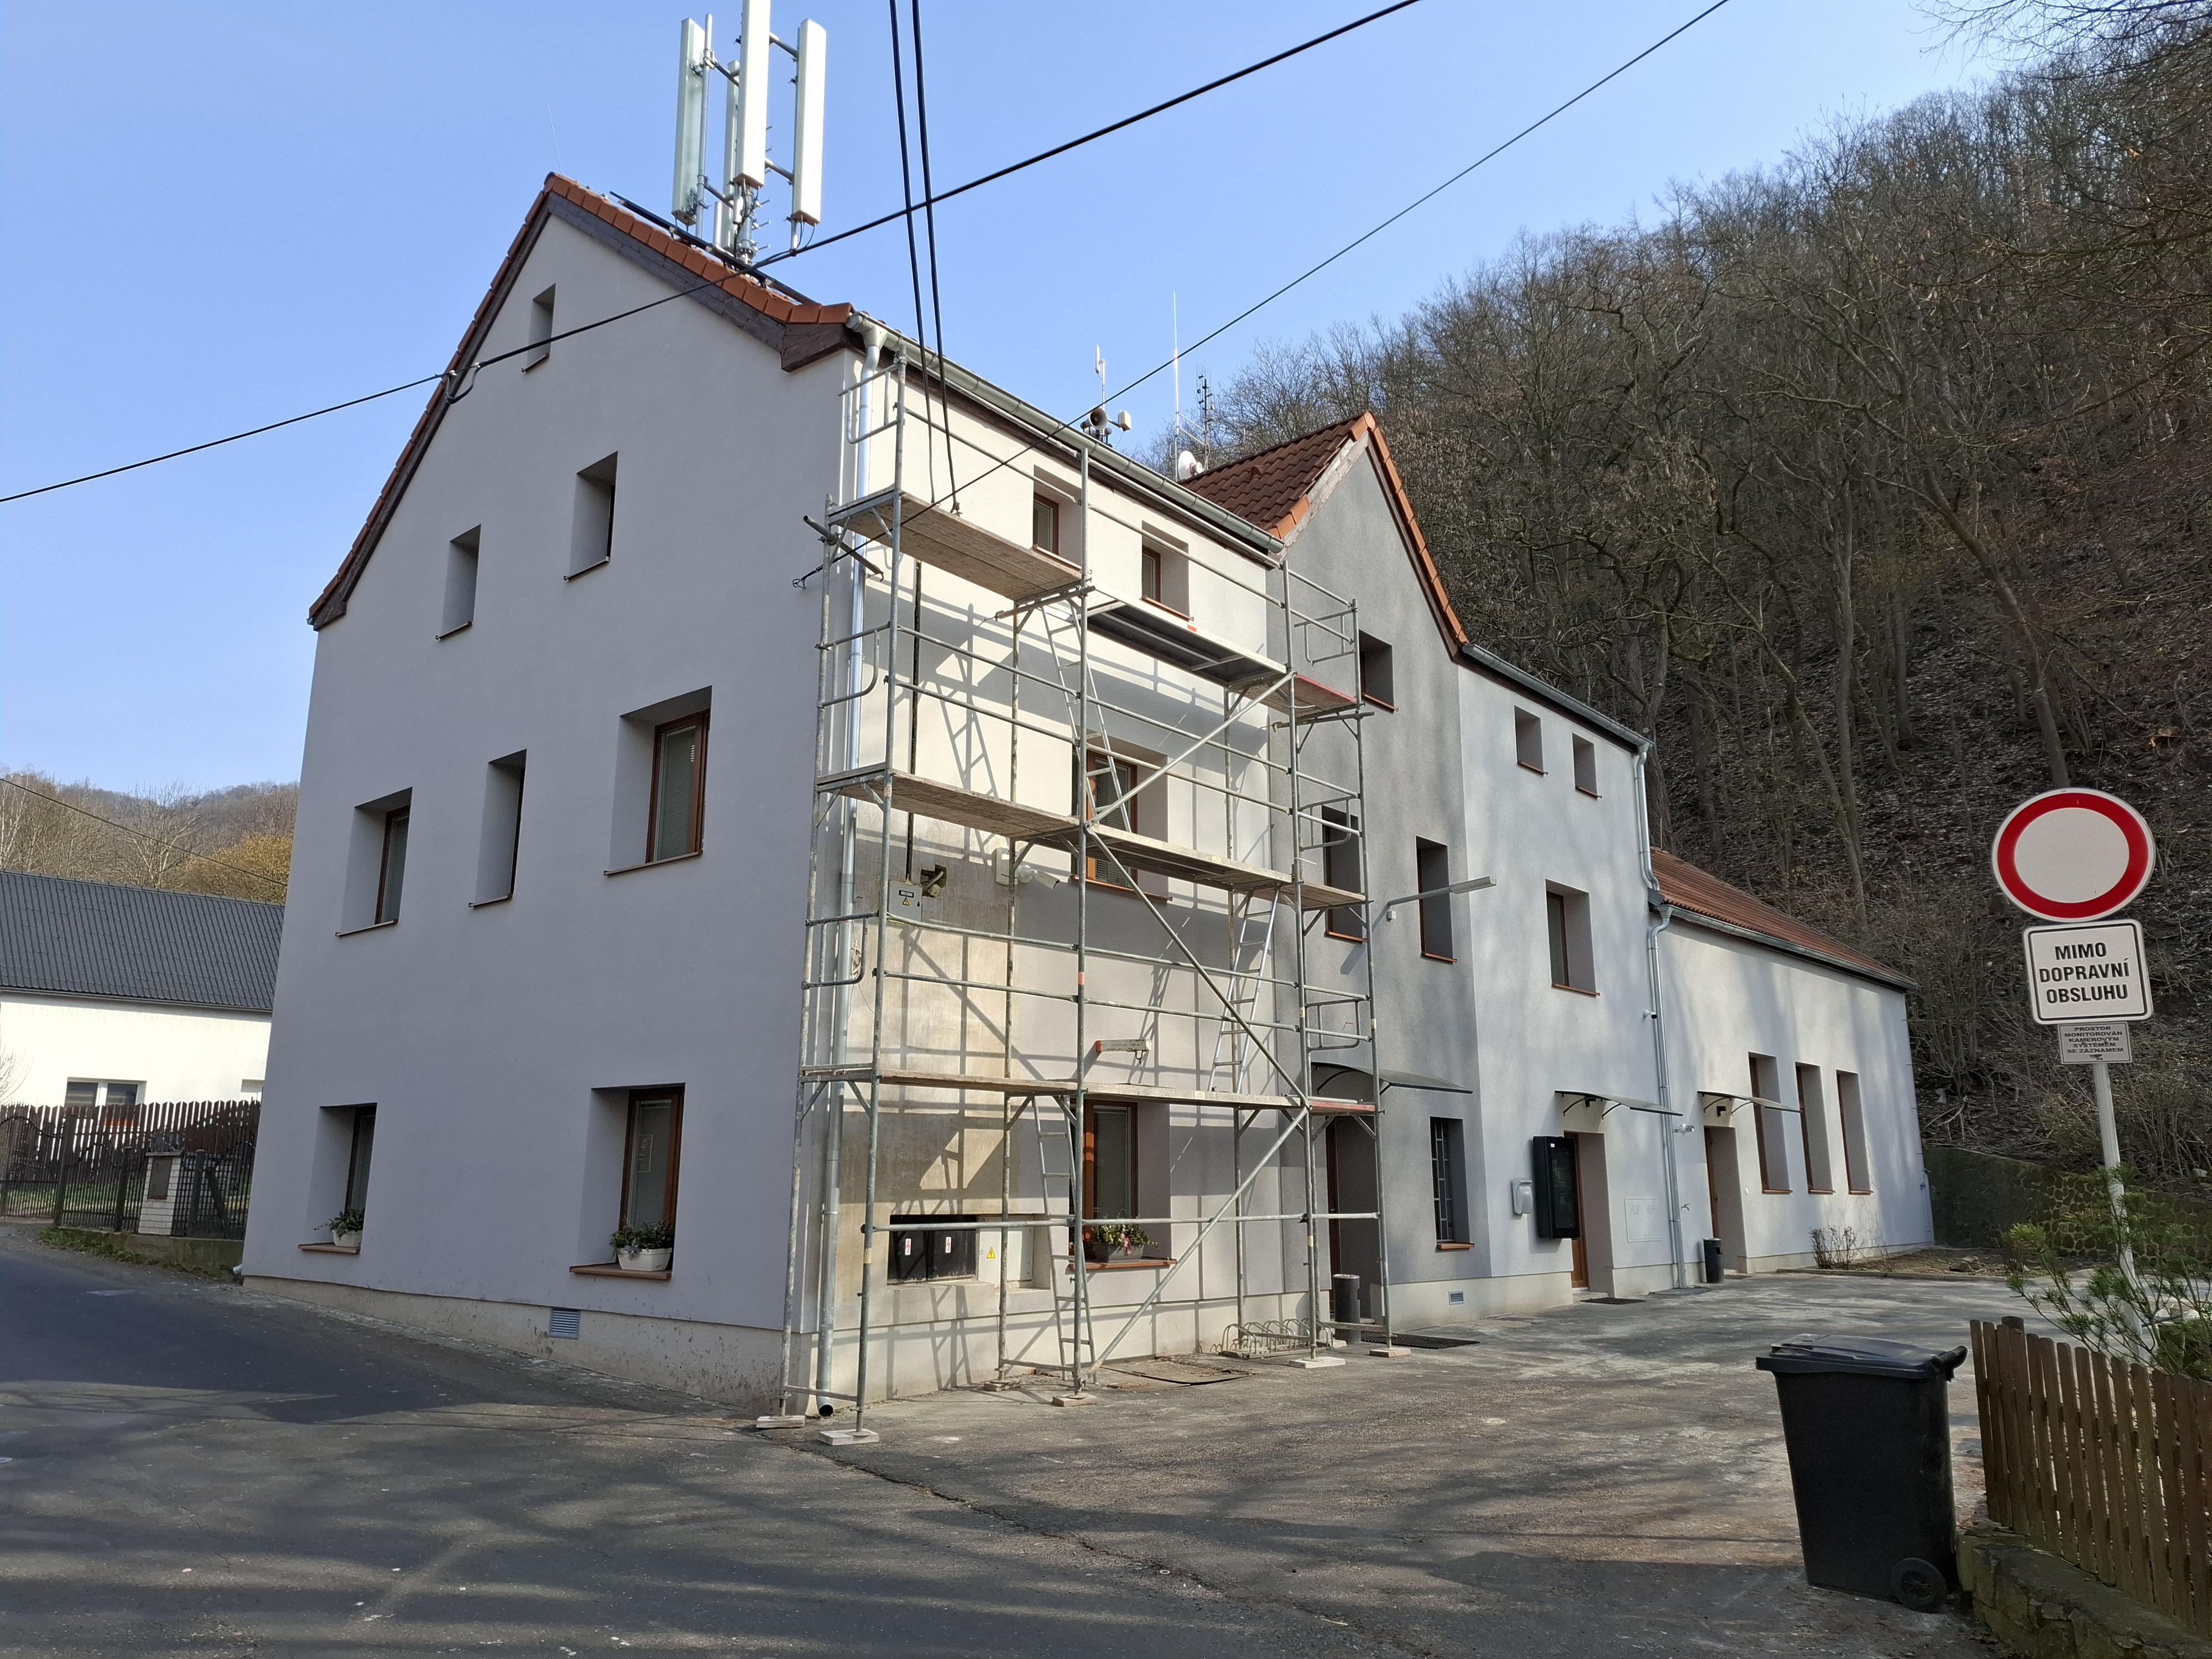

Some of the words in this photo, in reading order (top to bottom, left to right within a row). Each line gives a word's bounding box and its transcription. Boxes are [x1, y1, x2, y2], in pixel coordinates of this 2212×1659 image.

[2054, 942, 2107, 960] MIMO
[2039, 958, 2130, 983] DOPRAVNÍ
[2046, 984, 2128, 1004] OBSLUHU
